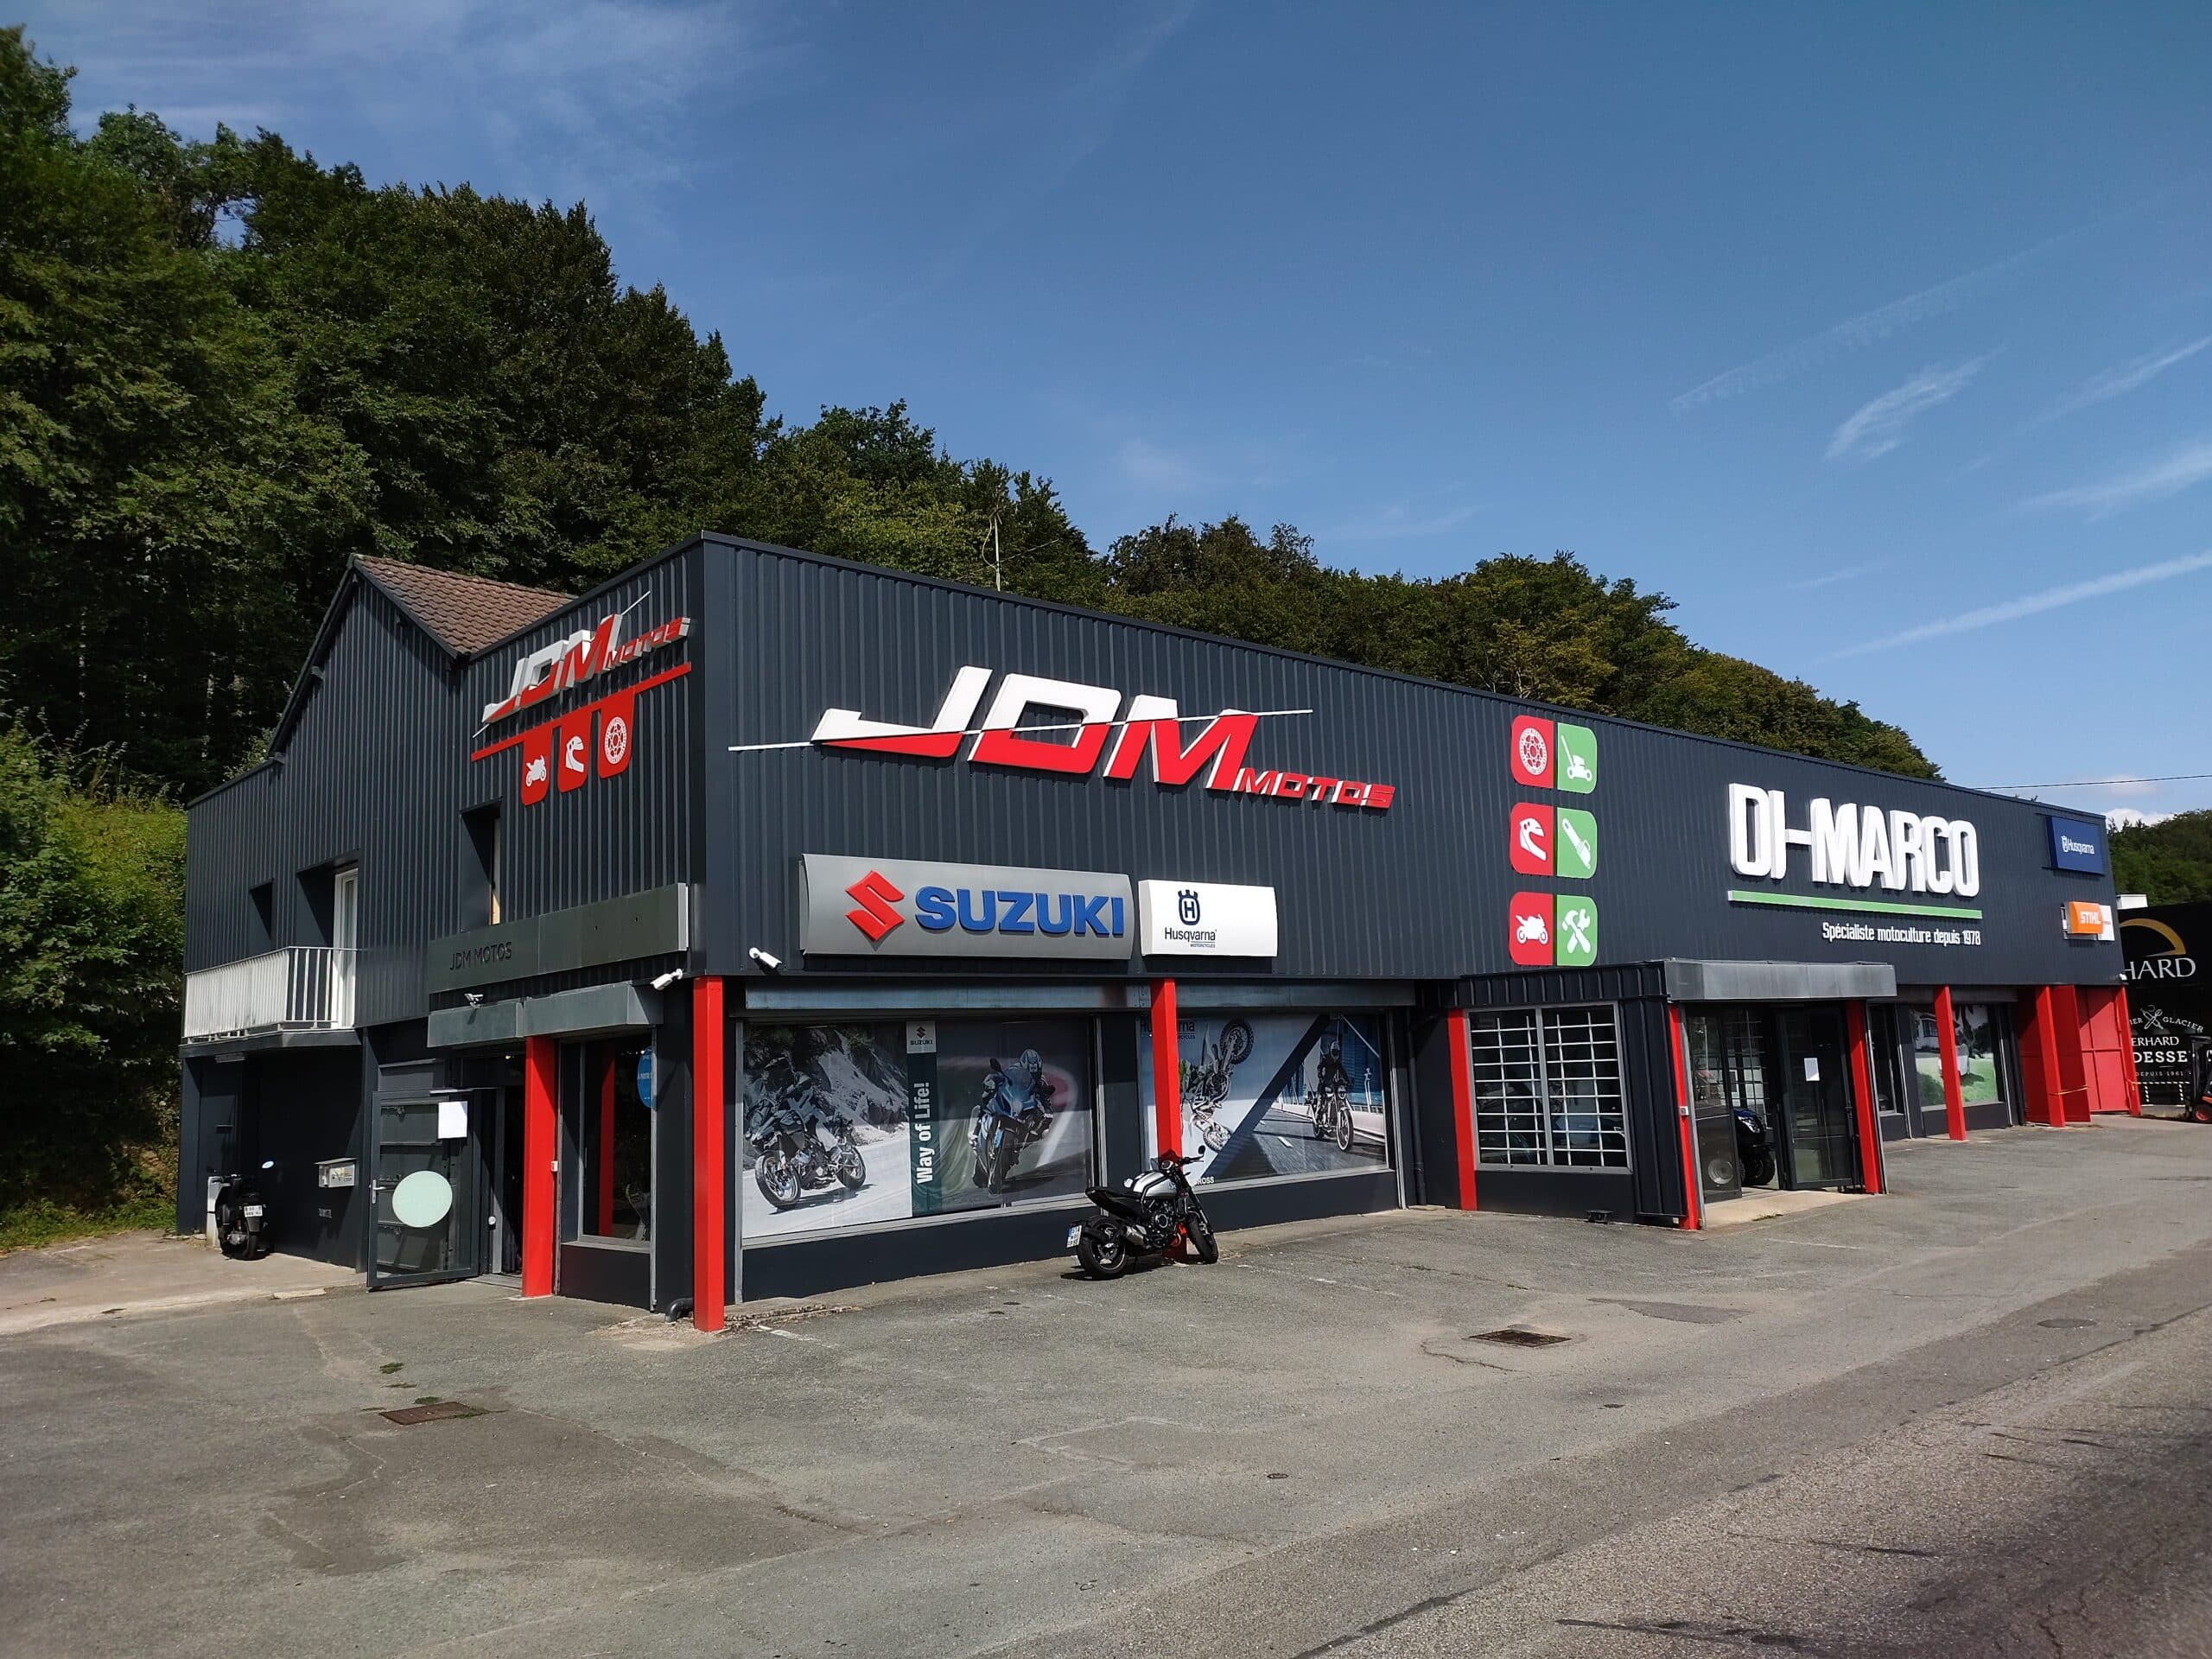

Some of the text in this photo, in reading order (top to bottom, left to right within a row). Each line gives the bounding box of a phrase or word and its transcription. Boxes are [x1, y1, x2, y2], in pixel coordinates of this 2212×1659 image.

[481, 613, 691, 723] JDM MOTOS
[810, 665, 1396, 810] JDM MOTOS
[1729, 783, 1980, 897] DI-MARCO
[2067, 838, 2095, 855] Husqvarna
[915, 886, 1125, 938] SUZUKI
[2080, 911, 2101, 925] STIHL
[1164, 927, 1216, 942] Husqvarna
[1822, 922, 1981, 947] Spécialiste motoculture depuis 1978
[449, 942, 512, 970] JDM MOTOS
[2163, 1016, 2204, 1033] GLACIER
[913, 1082, 935, 1184] Way of Life!
